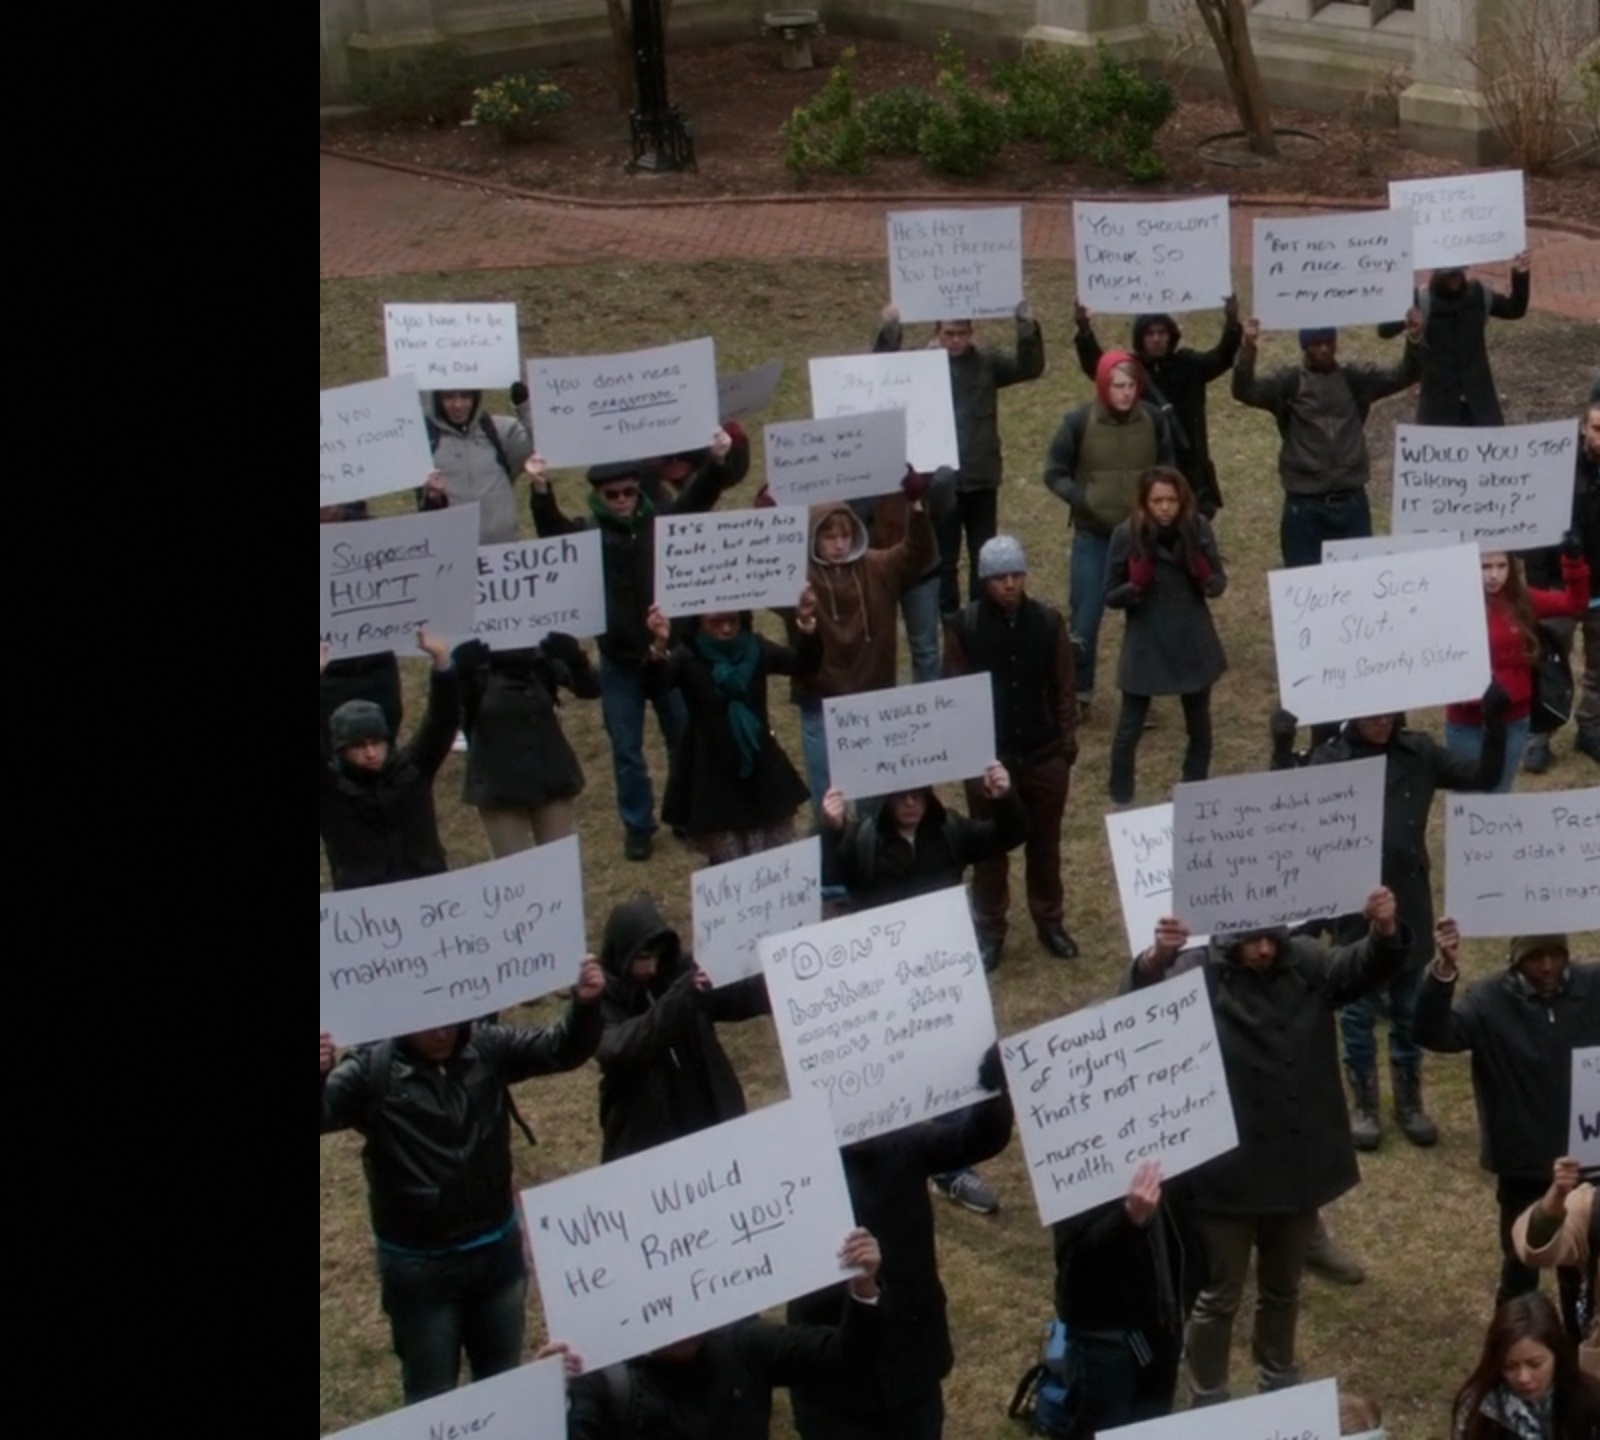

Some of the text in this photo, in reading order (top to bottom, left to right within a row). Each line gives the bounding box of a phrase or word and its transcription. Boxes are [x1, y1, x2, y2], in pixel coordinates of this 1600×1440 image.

[1153, 244, 1184, 264] SO
[1477, 442, 1519, 461] YOU
[1402, 471, 1530, 494] Talking about
[1402, 498, 1421, 512] IT
[717, 517, 764, 530] mostly
[331, 538, 431, 572] Supposed
[528, 609, 580, 629] SISTER
[1299, 627, 1311, 649] a
[1422, 644, 1470, 667] Sister
[1195, 783, 1356, 825] If you want
[1183, 811, 1357, 844] to have why
[1454, 805, 1523, 836] "Don't
[1186, 835, 1374, 878] did you go upstairs
[1463, 850, 1493, 864] you
[420, 884, 525, 928] are you
[1189, 885, 1233, 908] with
[330, 900, 561, 990] making this up?"
[496, 952, 556, 984] mom
[788, 950, 976, 1026] bother telling
[1114, 1016, 1135, 1032] no
[1146, 989, 1198, 1023] signs
[1030, 1048, 1126, 1093] of injury
[1103, 1075, 1139, 1101] not
[1118, 1089, 1217, 1139] at student
[1051, 1127, 1190, 1191] health center
[565, 1267, 615, 1297] He
[641, 1296, 673, 1323] my
[429, 1412, 495, 1440] Never
